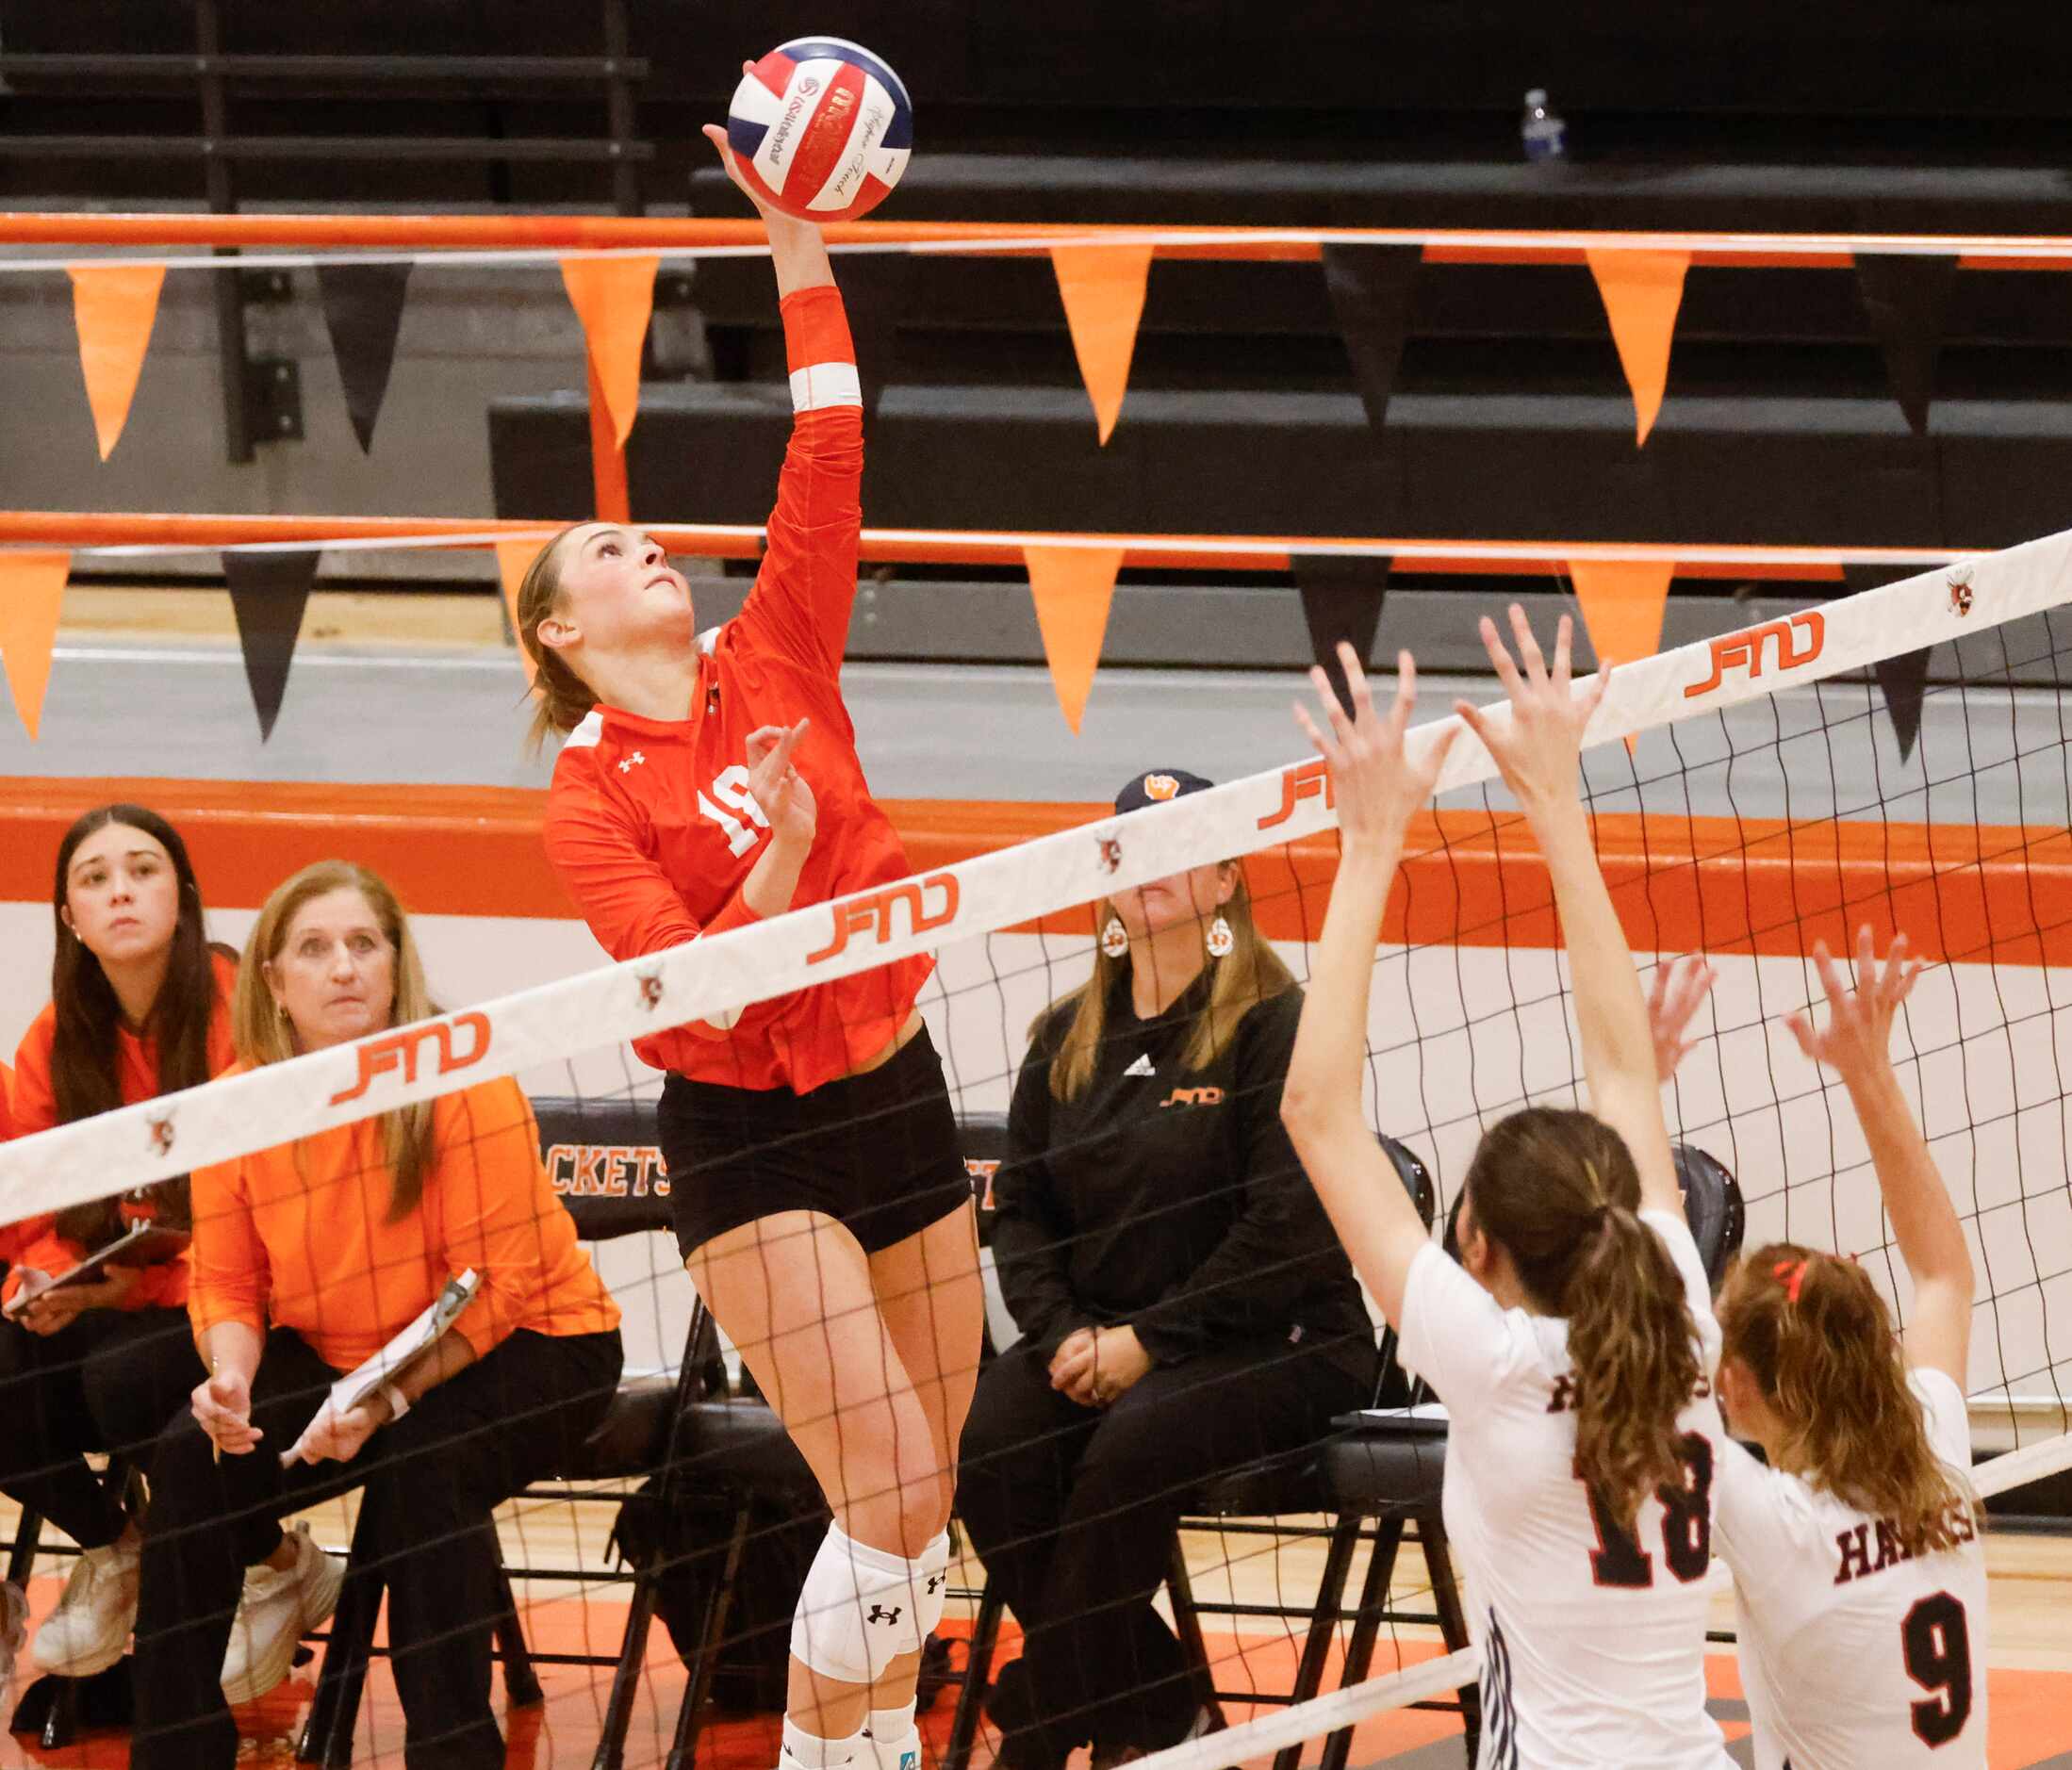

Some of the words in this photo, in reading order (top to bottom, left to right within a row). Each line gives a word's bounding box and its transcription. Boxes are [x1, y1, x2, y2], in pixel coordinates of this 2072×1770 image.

[834, 153, 865, 196] Touch
[1571, 1430, 1715, 1590] 18
[1899, 1589, 1974, 1750] 9
